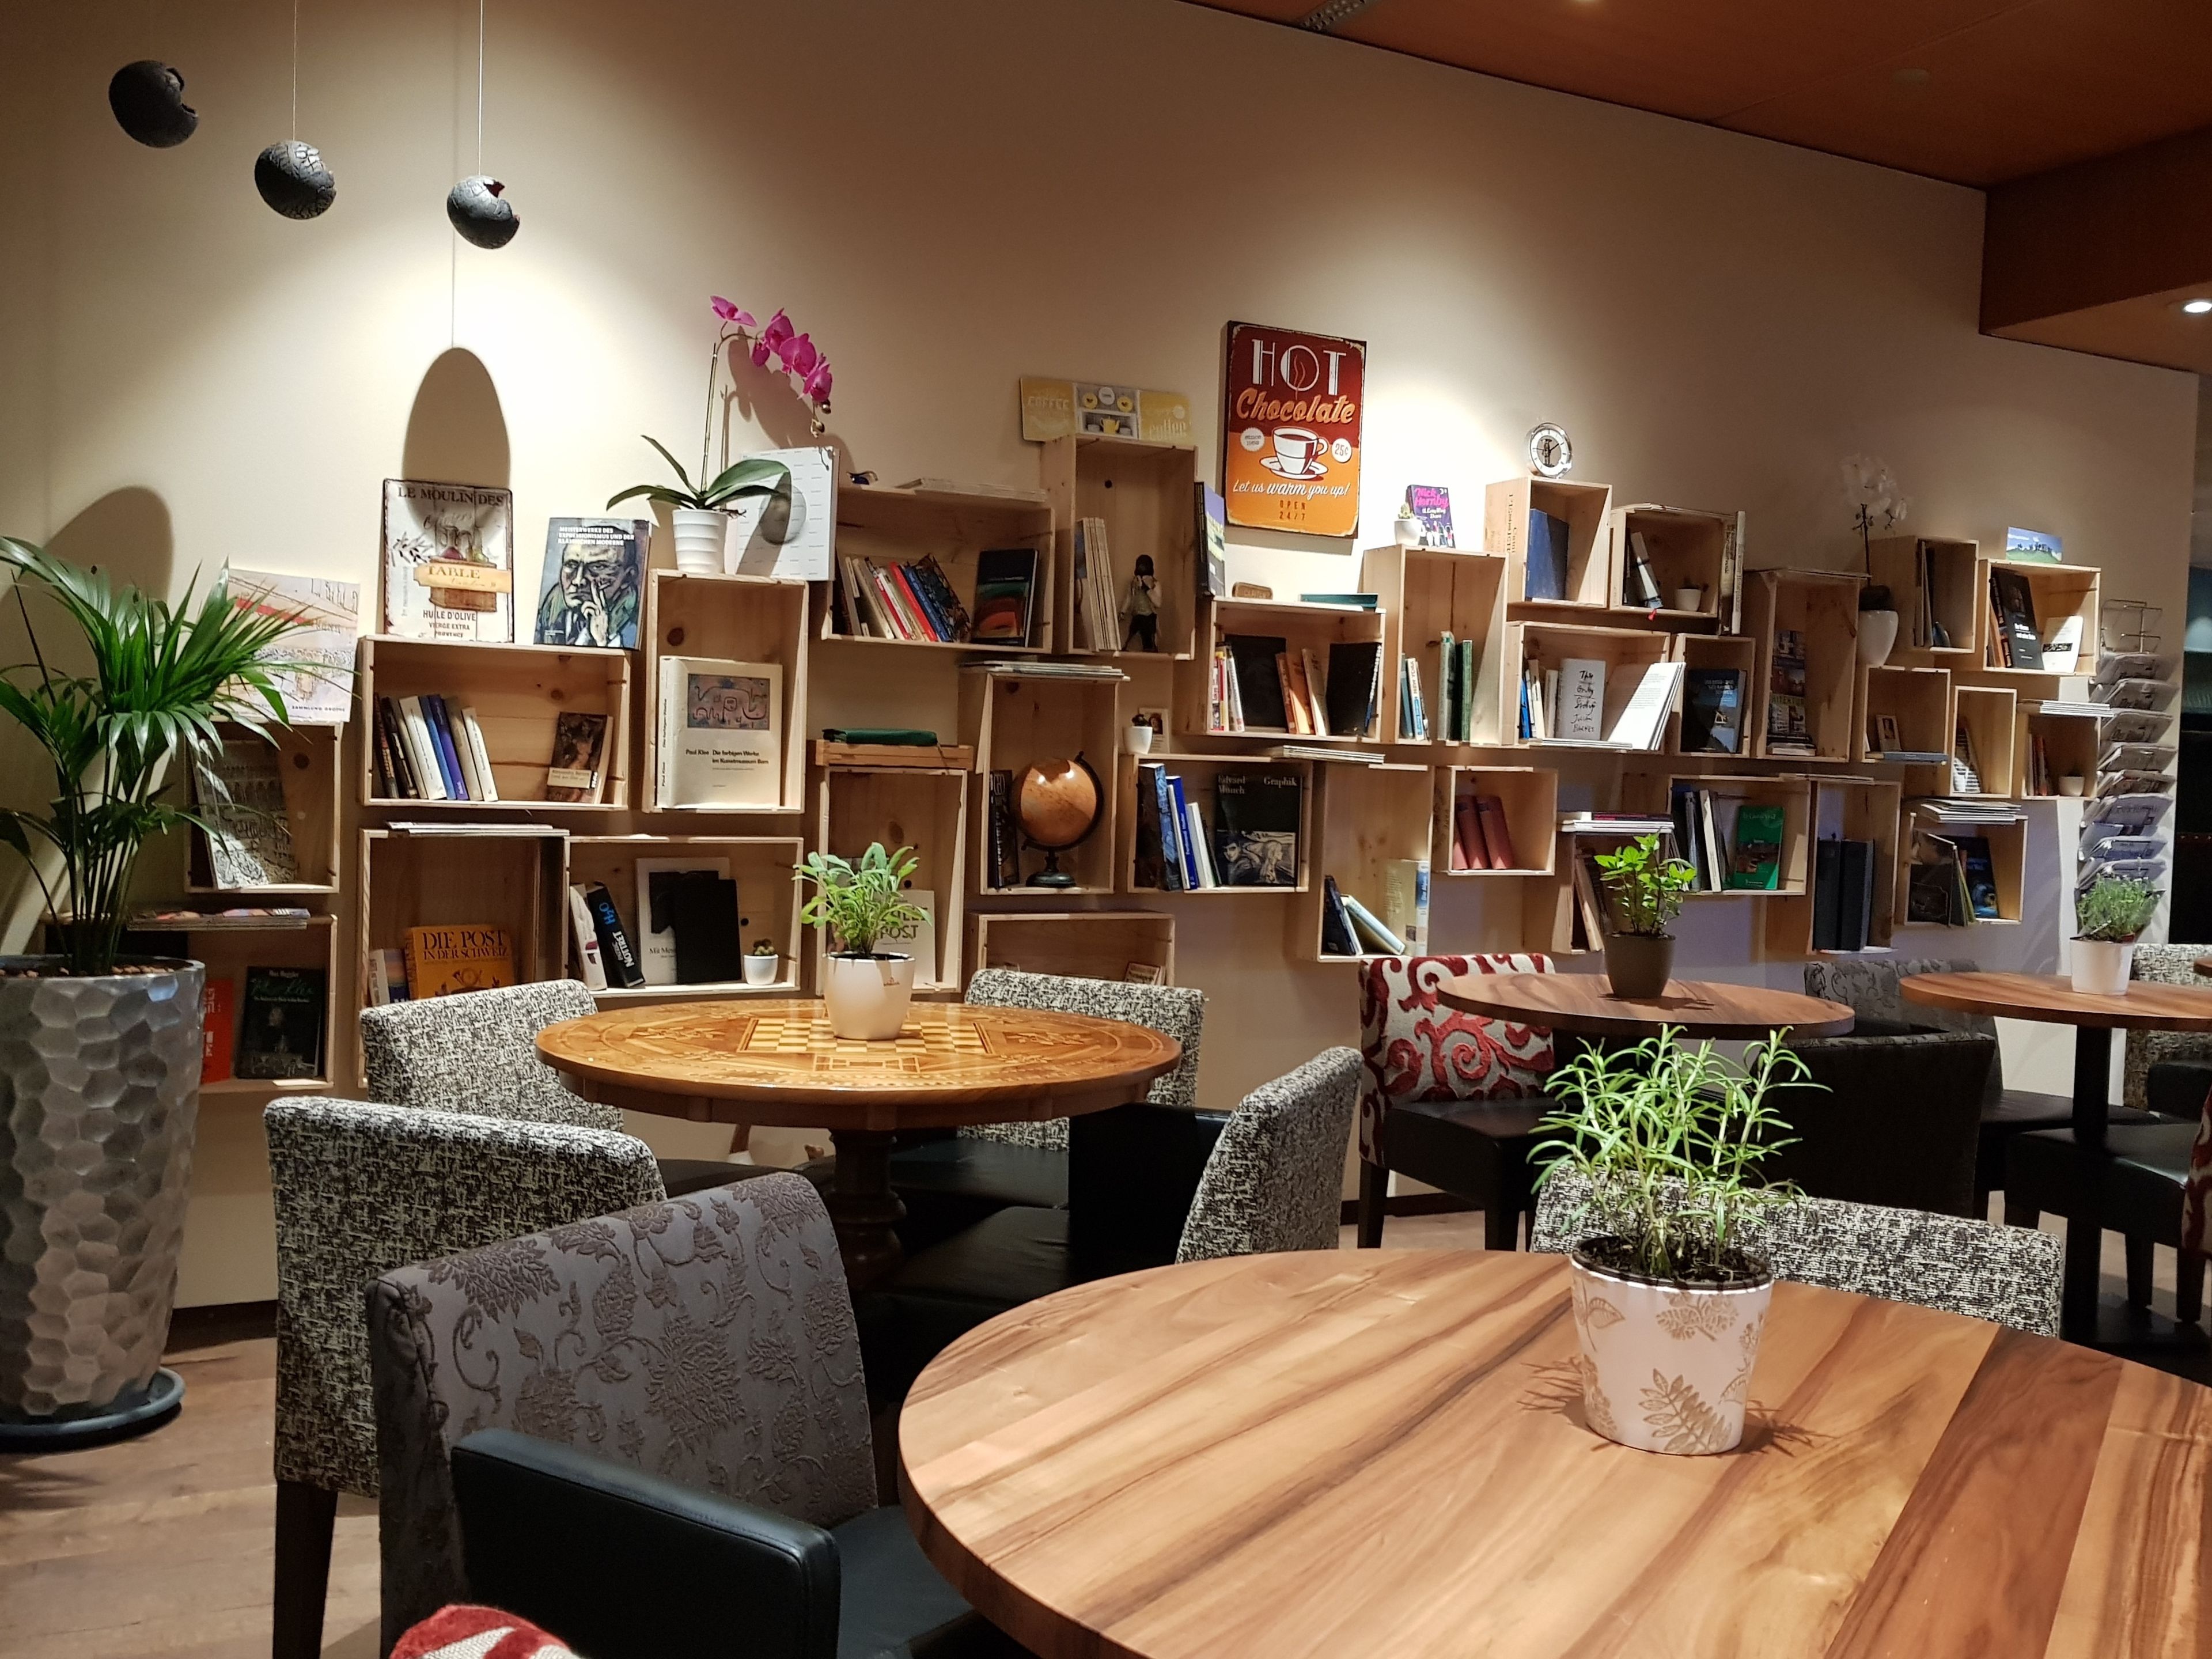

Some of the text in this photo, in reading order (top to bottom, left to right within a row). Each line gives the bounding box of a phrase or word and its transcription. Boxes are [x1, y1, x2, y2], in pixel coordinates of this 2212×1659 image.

[1252, 339, 1347, 396] HOT
[1236, 387, 1356, 424] Chocolate
[1334, 444, 1349, 456] 25¢
[1233, 479, 1351, 500] Let us warm you up!
[1415, 487, 1437, 497] Nick
[397, 487, 504, 506] LE MOULIN DES
[1415, 494, 1449, 510] Hornby
[1279, 499, 1306, 510] OPEN
[1279, 511, 1306, 521] 24/7
[559, 525, 602, 533] MEISTERWERKE
[558, 532, 609, 540] EXPRESSIONISMUS
[428, 564, 480, 579] TABLE
[423, 609, 476, 622] HUILE D'OLIVE
[1218, 775, 1298, 788] Edvard Graphik
[1218, 785, 1245, 794] Munch
[880, 925, 919, 940] POST
[423, 930, 506, 950] DIE POST
[423, 946, 509, 960] IN DER SCHWEIZ
